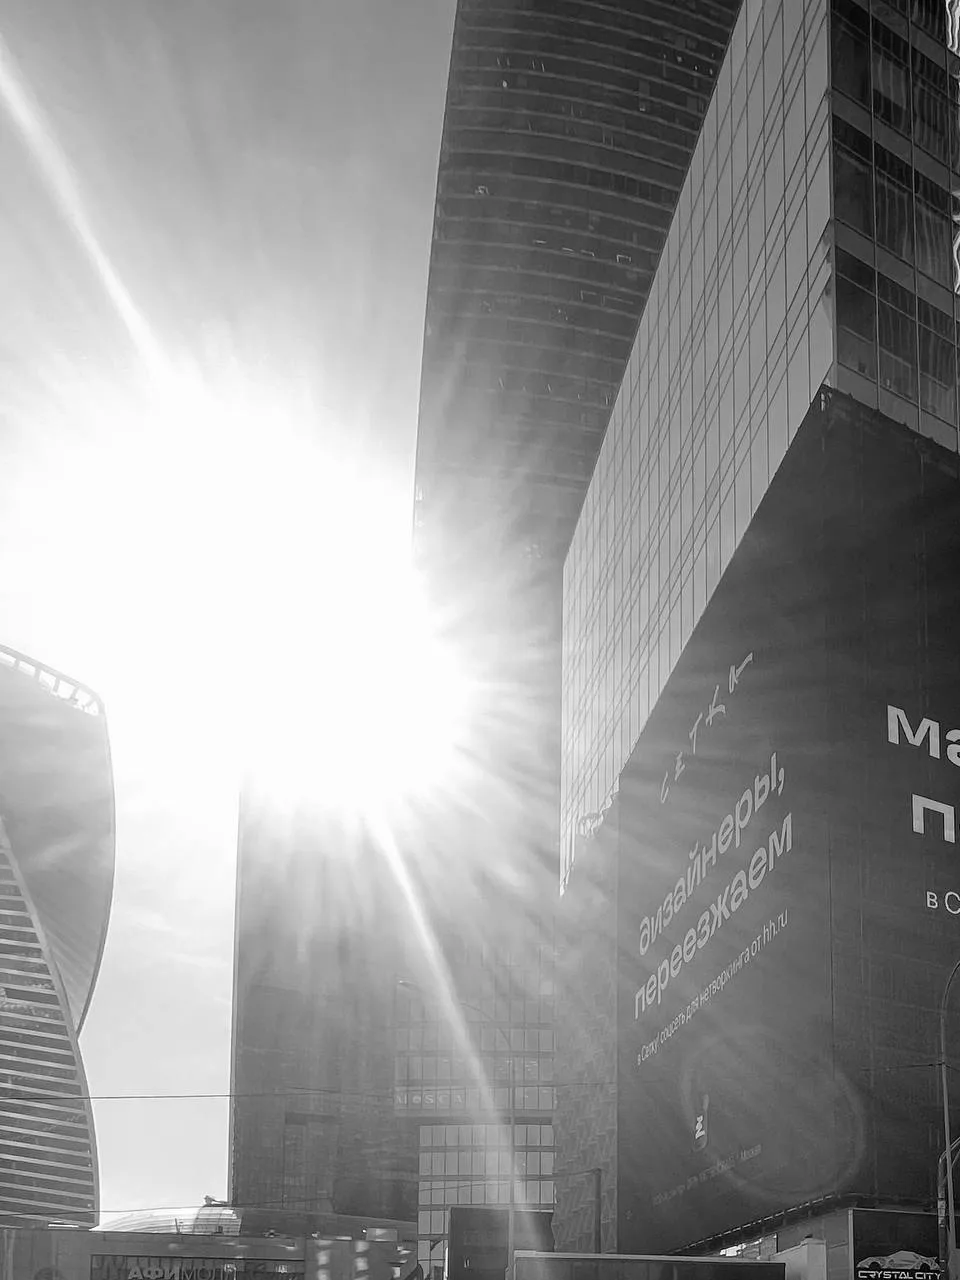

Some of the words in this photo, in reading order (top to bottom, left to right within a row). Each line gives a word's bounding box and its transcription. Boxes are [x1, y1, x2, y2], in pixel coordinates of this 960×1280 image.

[635, 812, 792, 1020] переезжаем
[640, 752, 785, 955] дизайнеры,
[926, 890, 938, 909] в
[660, 1011, 686, 1044] соцсеть
[751, 934, 763, 957] от
[763, 907, 788, 948] hh.ru
